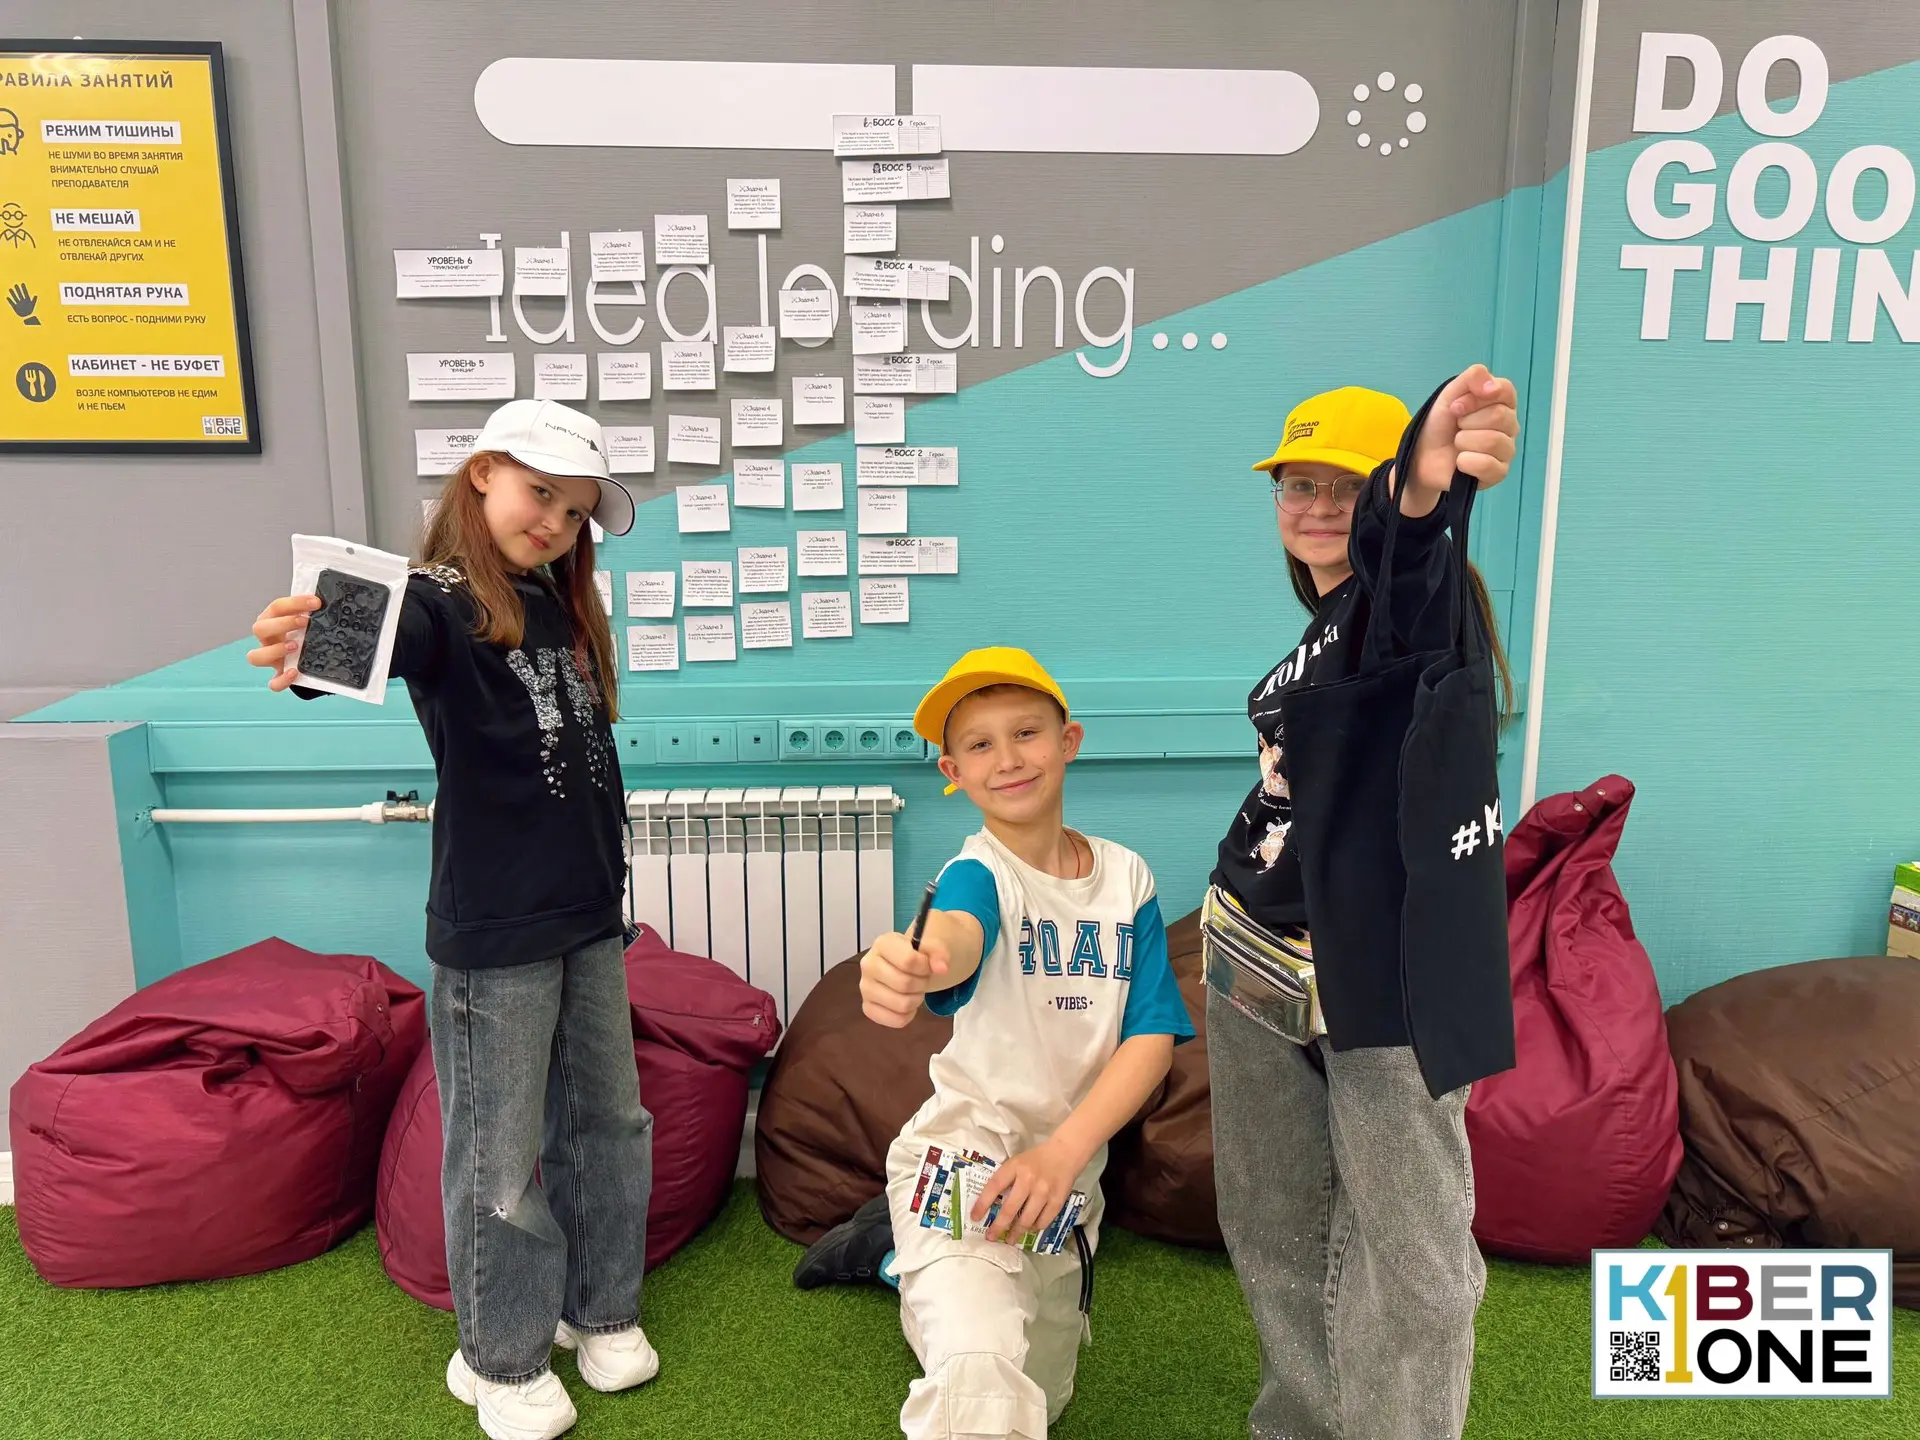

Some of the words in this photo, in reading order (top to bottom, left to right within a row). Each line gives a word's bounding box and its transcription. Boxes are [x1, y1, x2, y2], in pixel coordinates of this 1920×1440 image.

[80, 71, 173, 88] ЗАНЯТИЙ
[1632, 32, 1829, 137] DO
[46, 124, 101, 137] РЕЖИМ
[105, 125, 174, 138] ТИШИНЫ
[48, 151, 60, 160] НЕ
[62, 151, 91, 160] ШУМИ
[94, 152, 106, 160] ВО
[108, 152, 140, 160] ВРЕМЯ
[142, 152, 183, 160] ЗАНЯТИЯ
[50, 165, 118, 174] ВНИМАТЕЛЬНО
[120, 164, 159, 174] СЛУШАЙ
[52, 180, 129, 188] ПРЕПОДАВАТЕЛЯ
[56, 212, 74, 224] НЕ
[78, 210, 134, 225] МЕШАЙ
[58, 238, 70, 247] НЕ
[72, 238, 132, 248] ОТВЛЕКАЙСЯ
[134, 240, 152, 248] САМ
[154, 240, 162, 248] И
[164, 240, 176, 248] НЕ
[60, 252, 108, 261] ОТВЛЕКАЙ
[110, 253, 144, 262] ДРУГИХ
[884, 262, 905, 270] БОСС
[908, 262, 913, 270] 4
[64, 286, 142, 300] ПОДНЯТАЯ
[146, 287, 183, 298] РУКА
[480, 231, 718, 346] Idea
[1620, 244, 1920, 343] THIN
[68, 314, 90, 323] ЕСТЬ
[92, 315, 128, 323] ВОПРОС
[136, 316, 182, 324] ПОДНИМИ
[184, 316, 206, 324] РУКУ
[72, 359, 136, 370] КАБИНЕТ
[151, 360, 170, 371] НЕ
[174, 360, 220, 371] БУФЕТ
[439, 360, 475, 368] УРОВЕНЬ
[892, 356, 912, 364] БОСС
[916, 356, 920, 364] 3
[76, 389, 106, 397] ВОЗЛЕ
[108, 389, 176, 398] КОМПЬЮТЕРОВ
[178, 390, 190, 398] НЕ
[192, 390, 218, 398] ЕДИМ
[78, 402, 84, 410] И
[86, 402, 98, 410] НЕ
[100, 402, 126, 410] ПЬЕМ
[216, 426, 242, 434] ONE
[894, 449, 915, 457] БОСС
[1056, 996, 1088, 1010] VIBES
